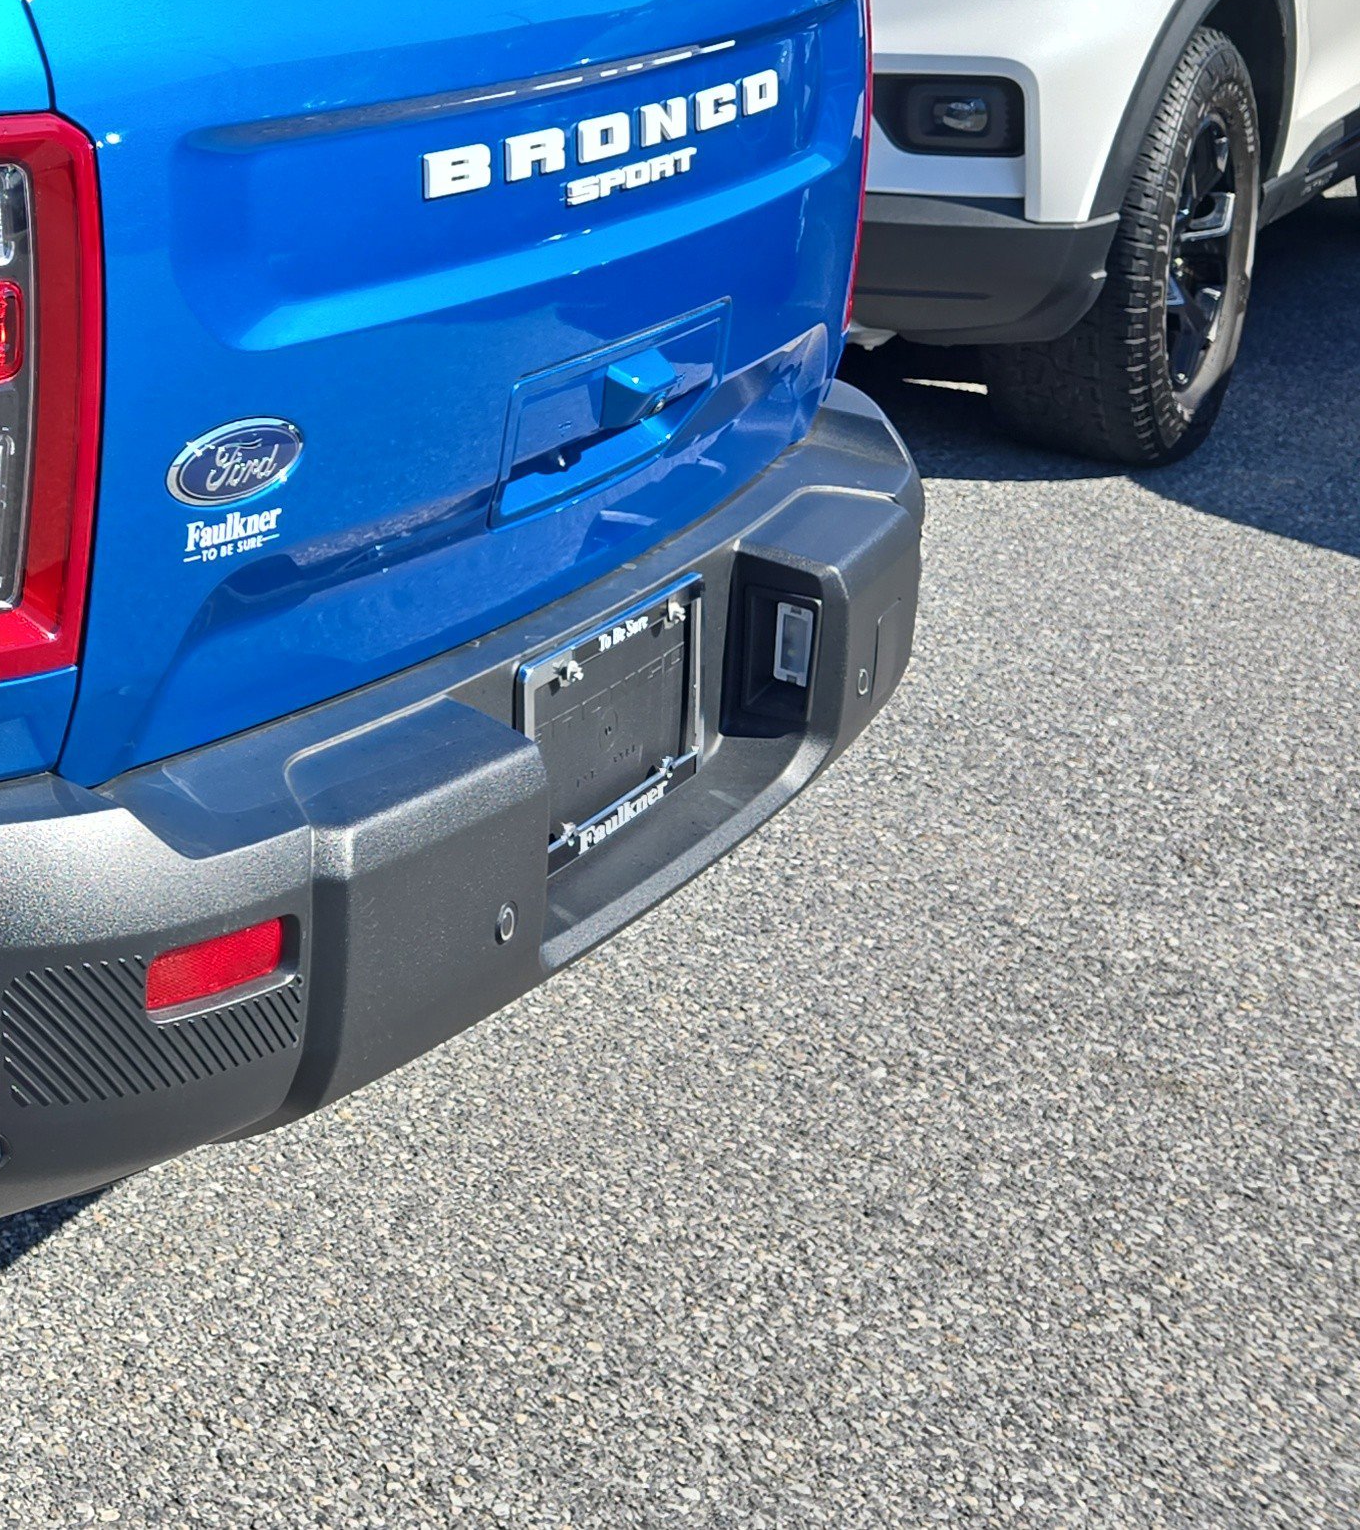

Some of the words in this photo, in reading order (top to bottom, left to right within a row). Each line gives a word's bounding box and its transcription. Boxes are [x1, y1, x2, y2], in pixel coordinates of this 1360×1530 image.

[422, 68, 778, 200] BRONCO
[565, 146, 697, 206] SPORT
[205, 437, 279, 491] Ford
[184, 507, 282, 552] Faulkner
[202, 546, 218, 562] TO
[220, 542, 234, 558] BE
[237, 535, 264, 553] SURE
[598, 633, 612, 652] To
[612, 626, 626, 645] Be
[625, 616, 649, 638] Sure
[578, 780, 668, 854] Faulkner
